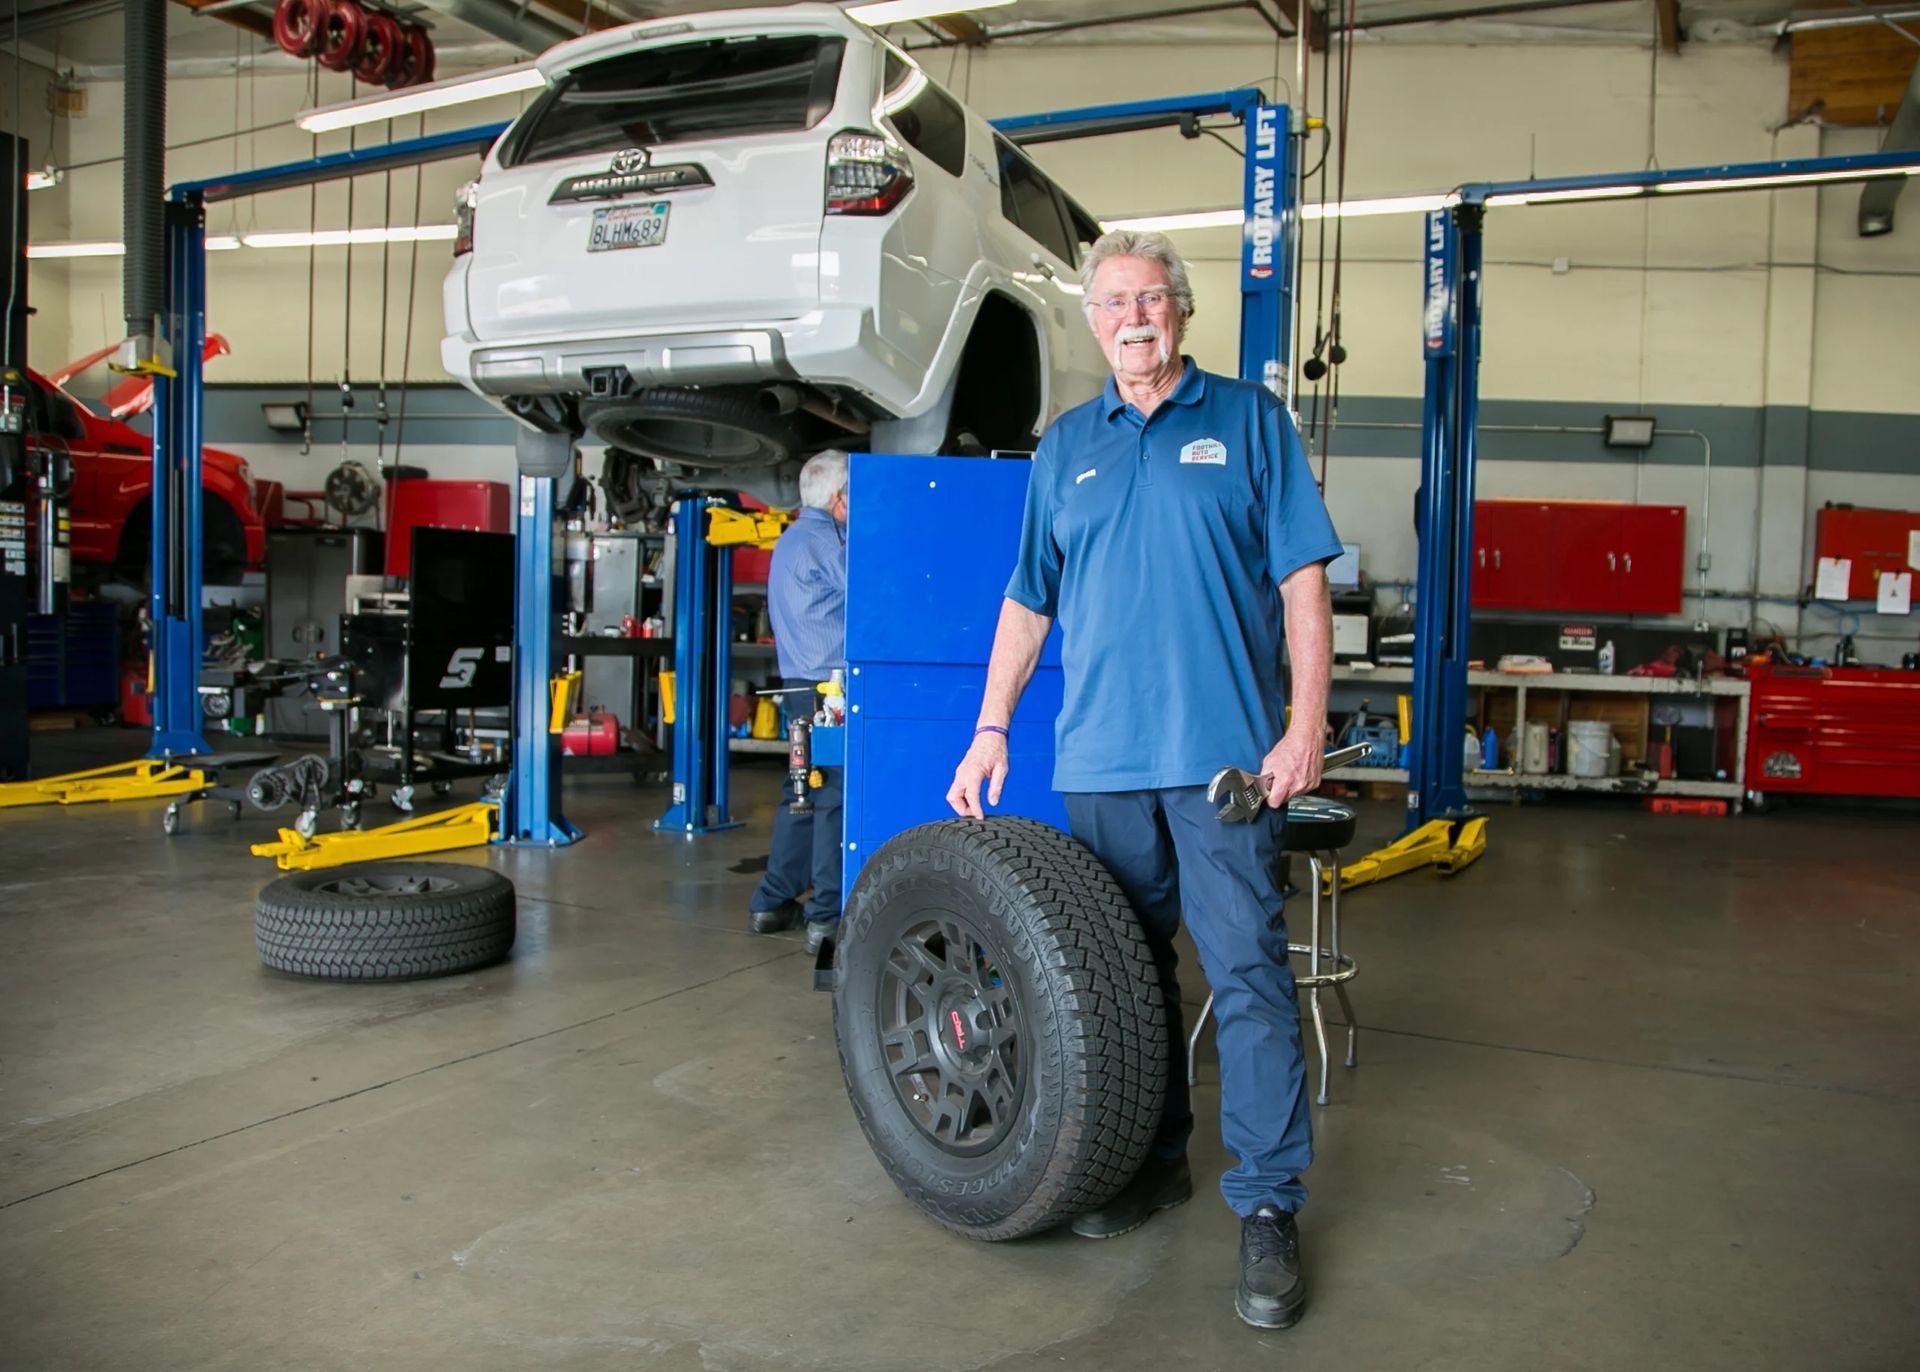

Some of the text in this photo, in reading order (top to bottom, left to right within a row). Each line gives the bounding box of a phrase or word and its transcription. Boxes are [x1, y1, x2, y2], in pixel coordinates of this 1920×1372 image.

[1255, 106, 1277, 160] LIFT
[593, 218, 661, 245] 8LHM689
[1252, 166, 1276, 265] ROTARY
[1430, 208, 1445, 252] LIFT
[1429, 257, 1444, 338] ROTARY
